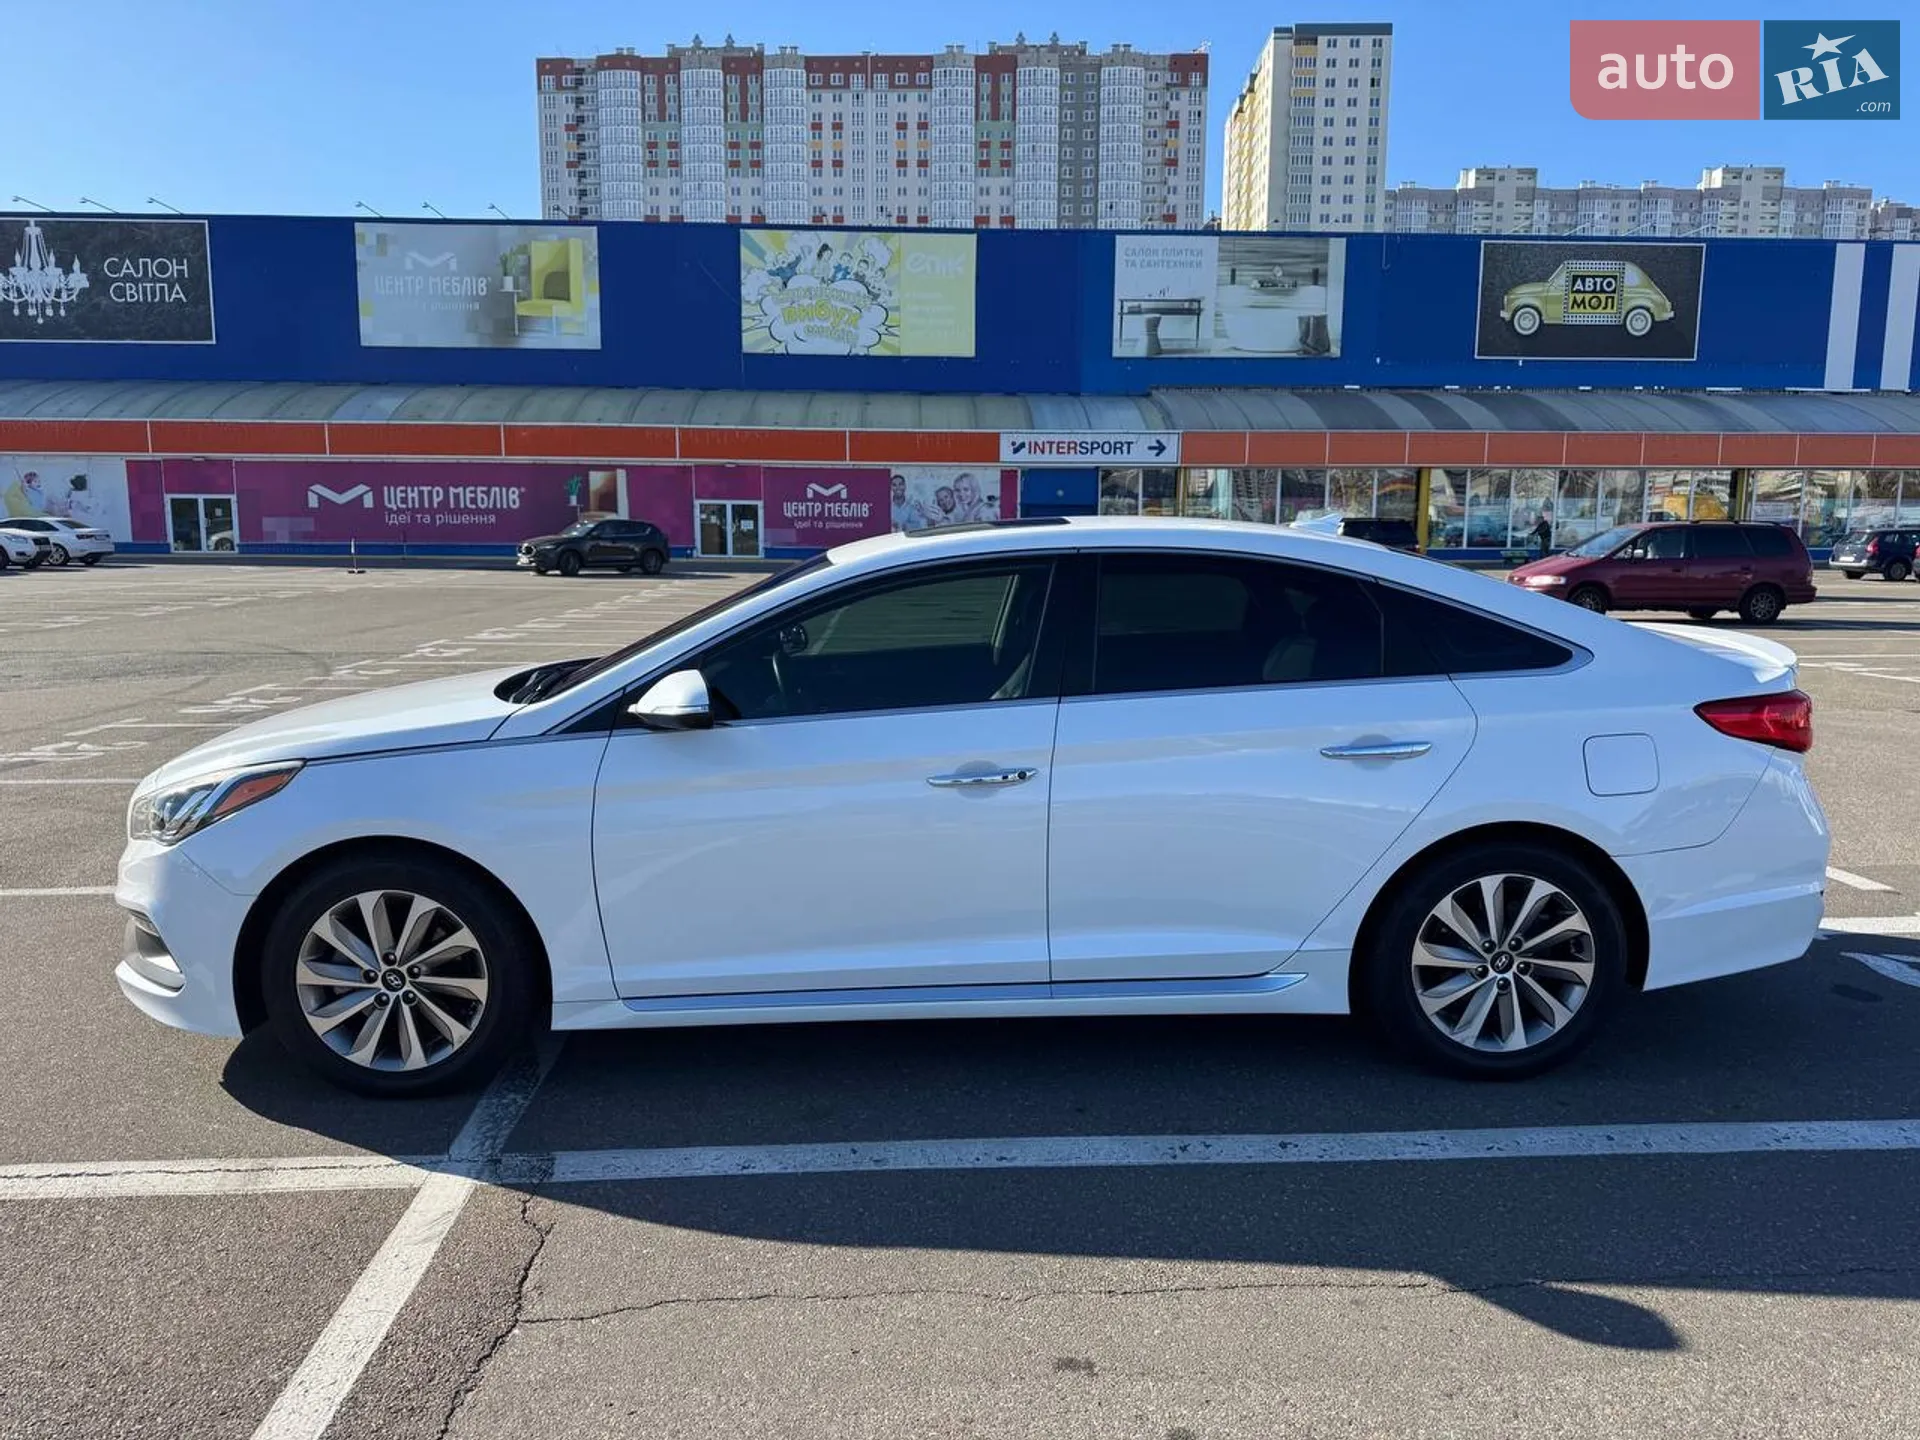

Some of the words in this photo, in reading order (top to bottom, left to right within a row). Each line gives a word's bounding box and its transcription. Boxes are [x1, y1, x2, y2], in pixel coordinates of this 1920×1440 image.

[103, 257, 188, 278] САЛОН
[1124, 258, 1138, 269] ТА
[109, 282, 187, 302] СВІТЛА
[375, 276, 423, 297] ЦЕНТР
[428, 276, 487, 296] МЕБЛІВ
[1573, 278, 1615, 291] АВТО
[1571, 295, 1615, 310] МОЛ
[1028, 441, 1134, 455] INTERSPORT
[383, 486, 444, 510] ЦЕНТР
[449, 486, 520, 509] МЕБЛІВ
[783, 502, 821, 517] ЦЕНТР
[824, 502, 870, 517] МЕБЛІВ
[416, 513, 431, 523] та
[436, 512, 496, 524] рішення
